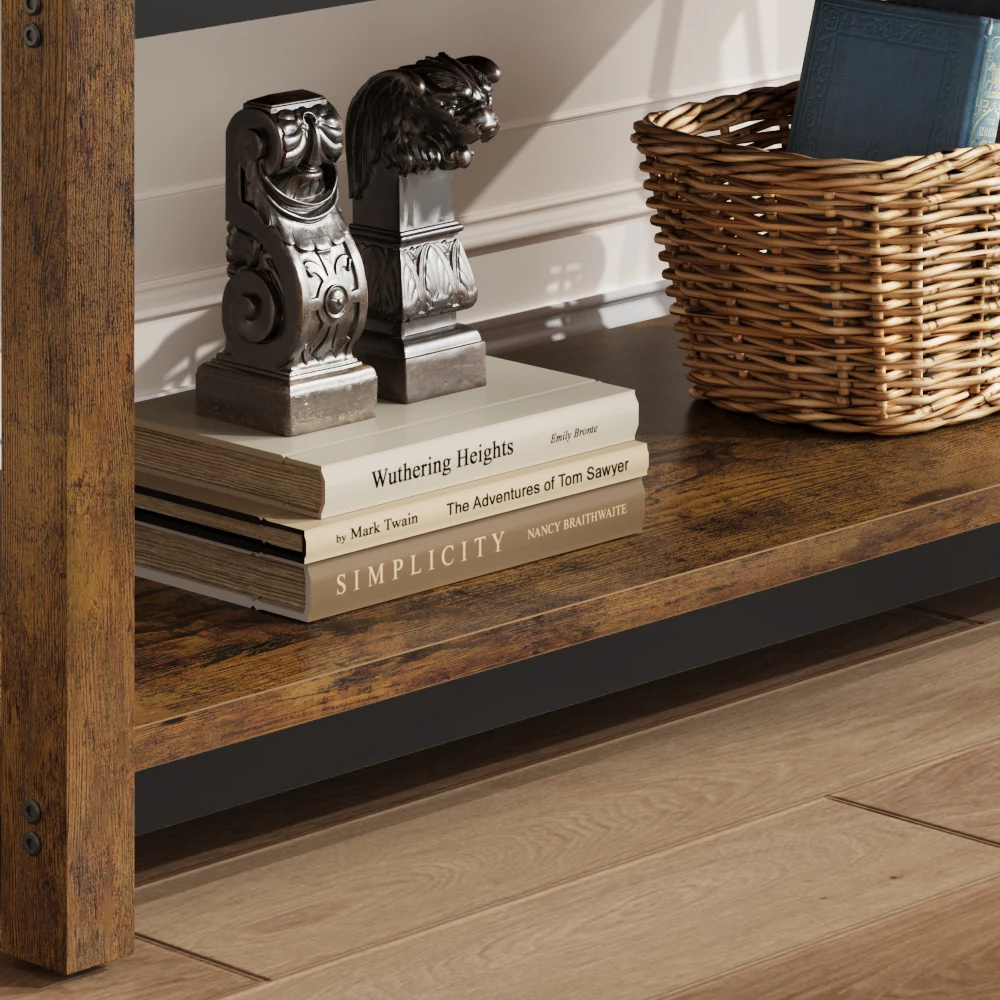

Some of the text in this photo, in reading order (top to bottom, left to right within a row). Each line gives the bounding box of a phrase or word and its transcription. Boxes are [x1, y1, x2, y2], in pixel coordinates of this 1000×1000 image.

[550, 425, 598, 444] Emily Bronte
[371, 440, 514, 489] Wuthering Heights
[446, 459, 630, 516] The Adventures of Tom Sawyer
[336, 513, 419, 545] by Mark Twain
[527, 503, 628, 540] NANCY BRAITHWAITE
[336, 531, 505, 596] SIMPLICITY
